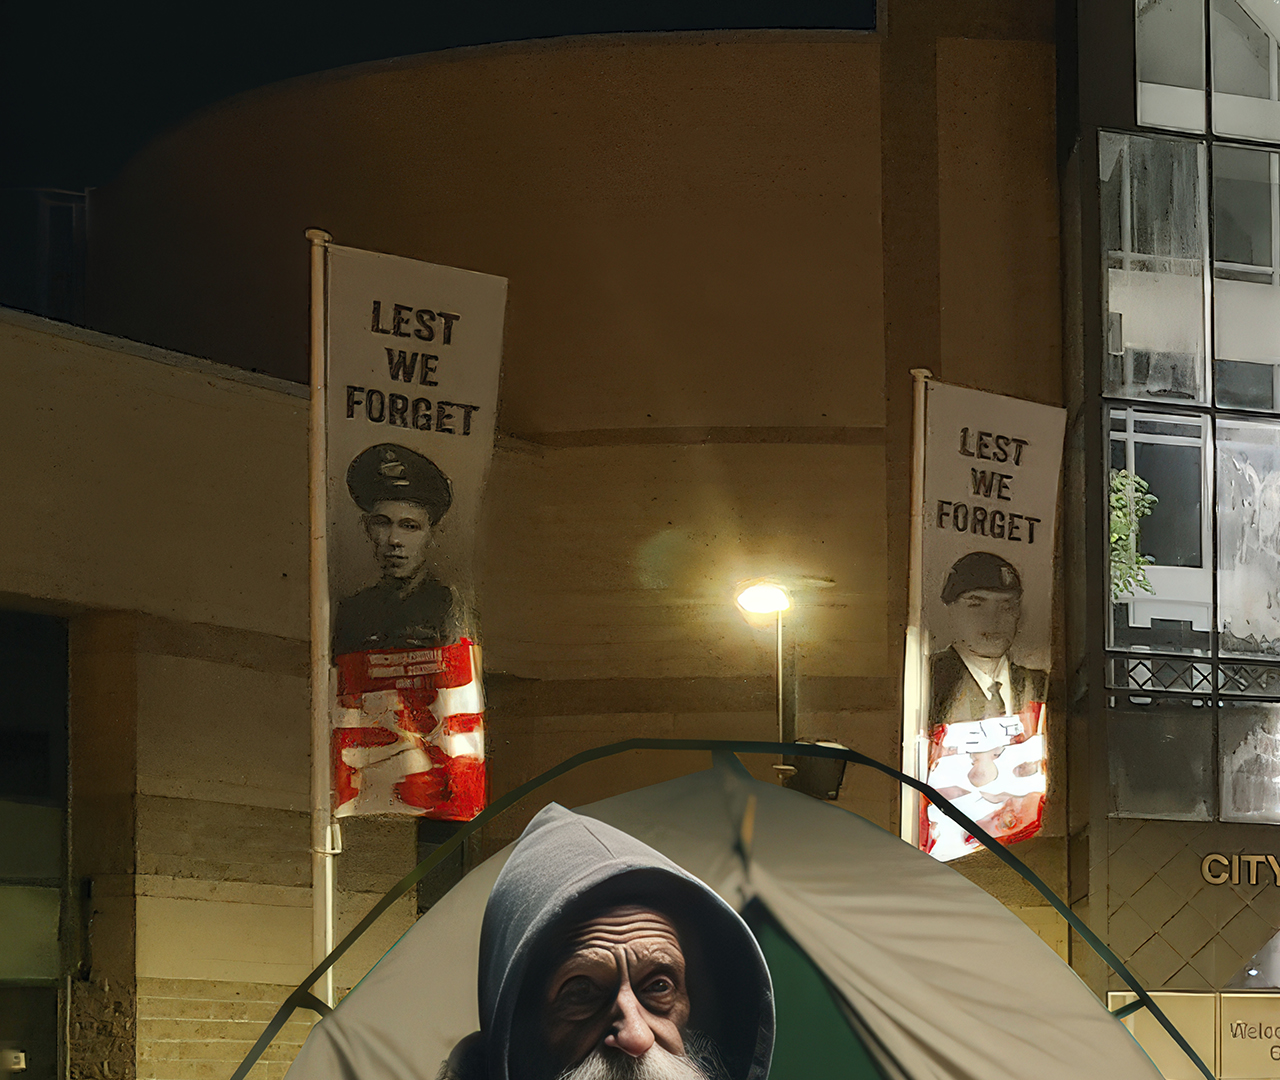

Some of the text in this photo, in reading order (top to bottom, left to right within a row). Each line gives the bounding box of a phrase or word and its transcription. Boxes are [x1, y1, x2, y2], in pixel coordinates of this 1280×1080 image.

[370, 300, 461, 345] LEST
[384, 346, 439, 387] WE
[346, 385, 480, 436] FORGET
[958, 427, 1029, 466] LEST
[971, 467, 1013, 501] WE
[936, 500, 1041, 544] FORGET
